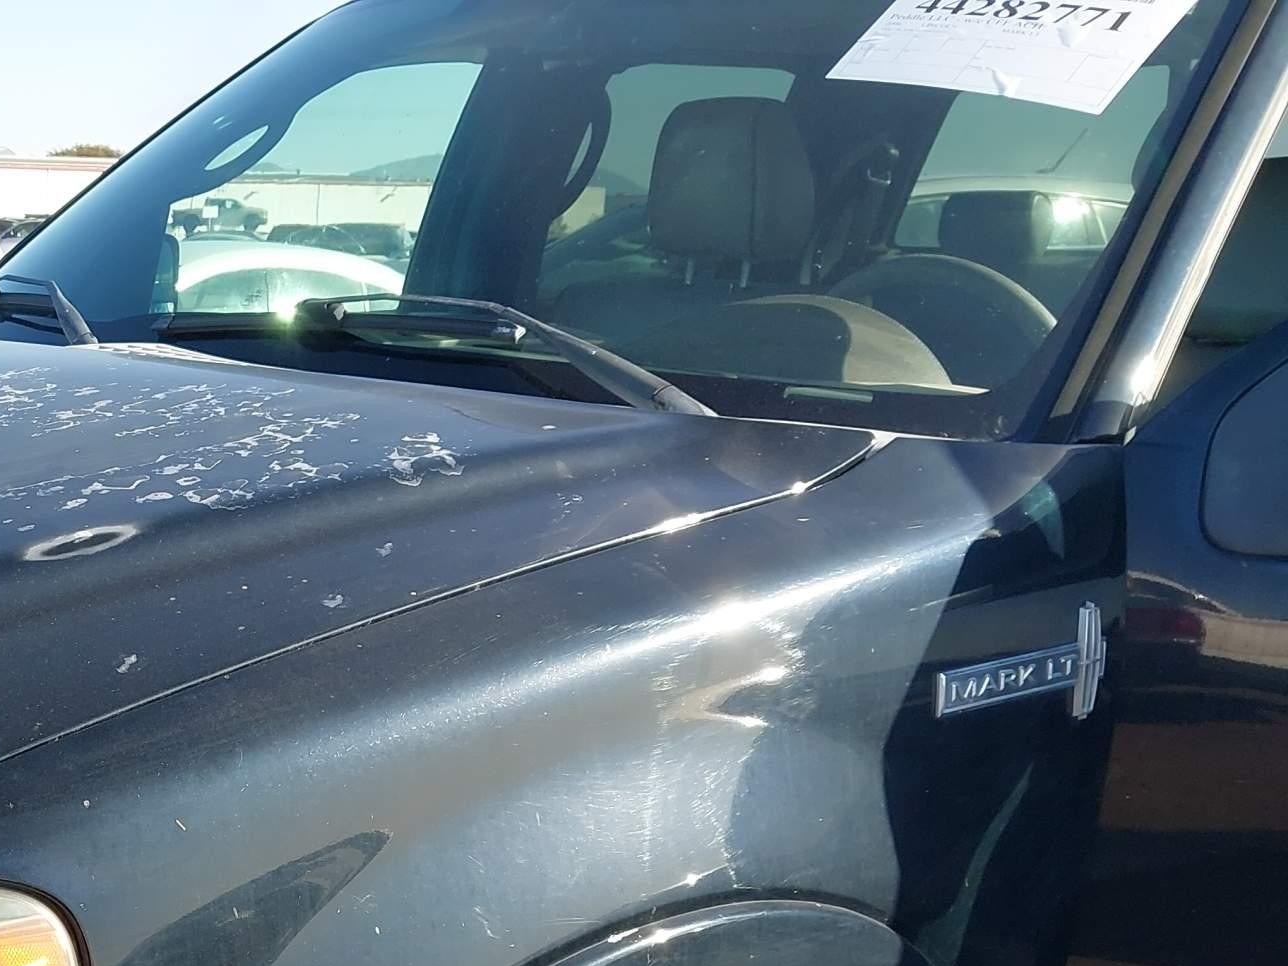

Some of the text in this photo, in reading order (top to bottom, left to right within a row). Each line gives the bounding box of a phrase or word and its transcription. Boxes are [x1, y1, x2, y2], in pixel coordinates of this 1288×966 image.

[915, 0, 1132, 32] 44282771
[951, 654, 1078, 702] MARK LT
